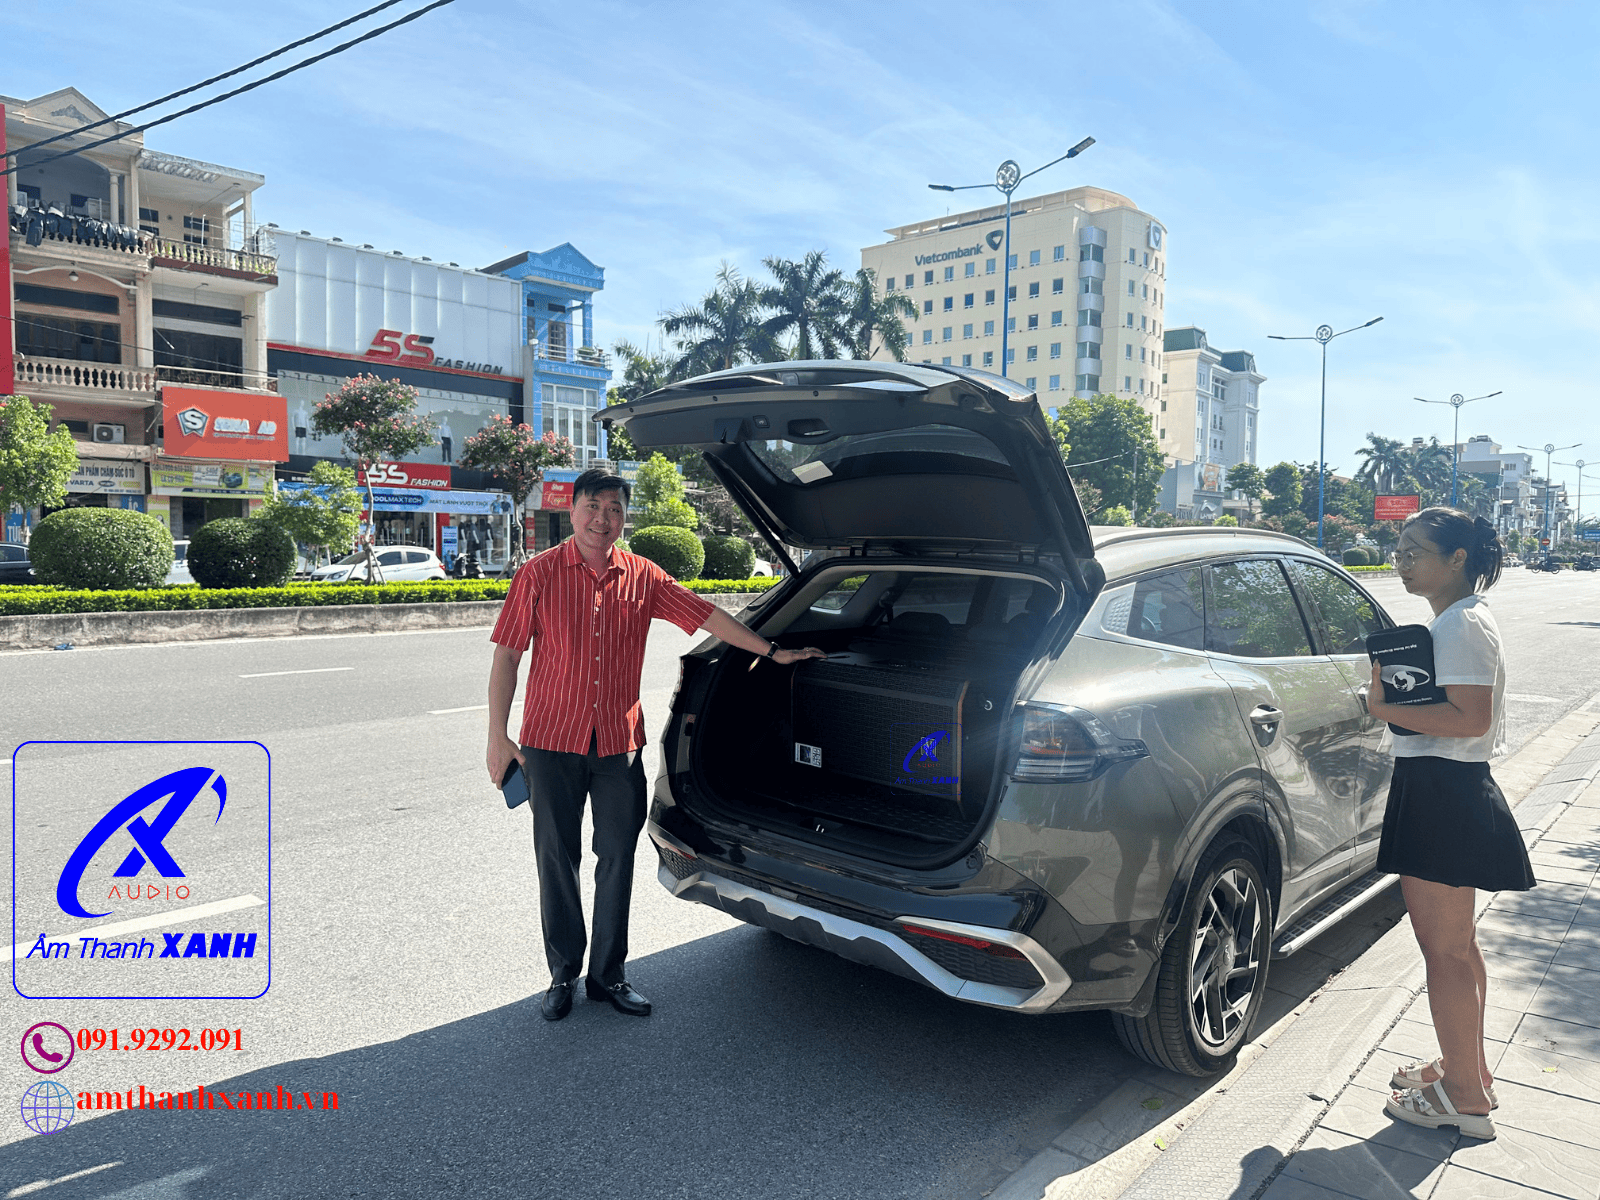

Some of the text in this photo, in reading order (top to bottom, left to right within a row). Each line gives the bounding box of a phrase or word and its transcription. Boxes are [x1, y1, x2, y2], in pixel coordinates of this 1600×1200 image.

[914, 242, 983, 266] Vietcombank
[364, 328, 503, 374] 5S FASHION
[363, 463, 448, 487] 5S FASHION
